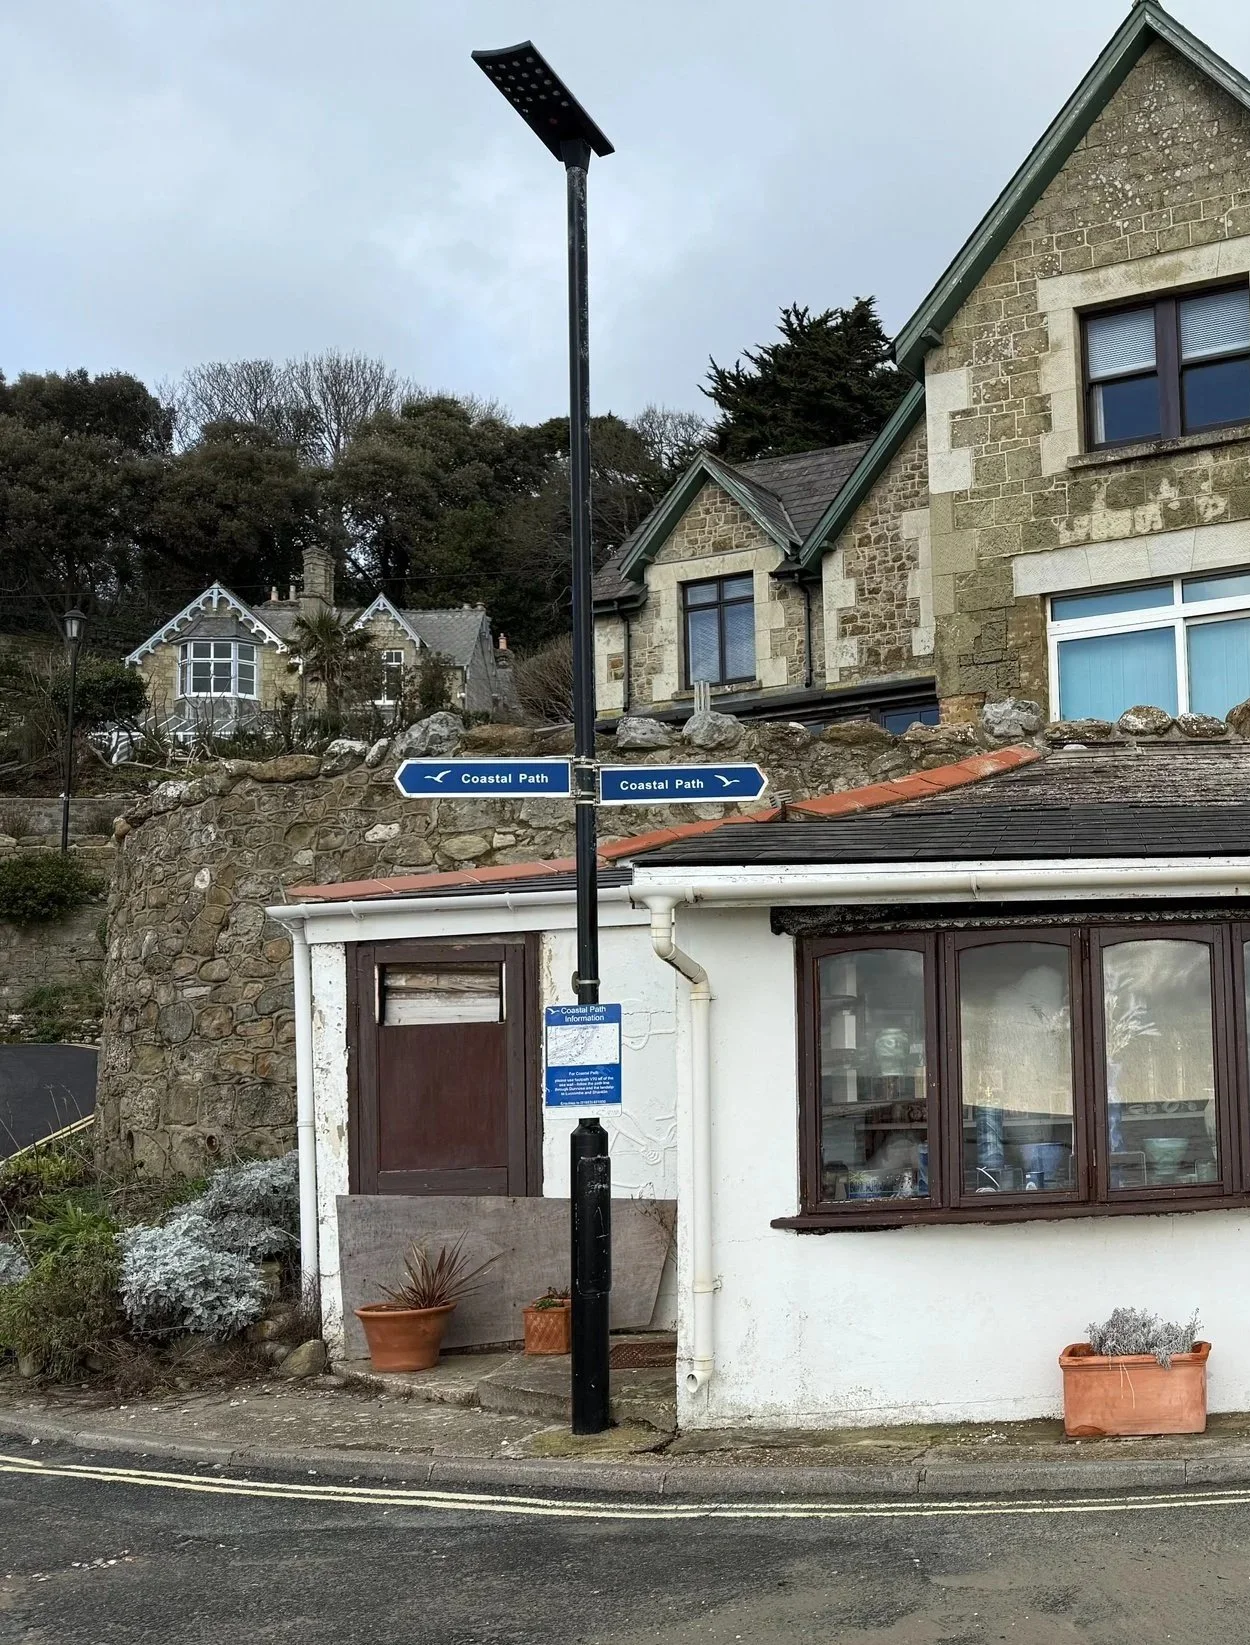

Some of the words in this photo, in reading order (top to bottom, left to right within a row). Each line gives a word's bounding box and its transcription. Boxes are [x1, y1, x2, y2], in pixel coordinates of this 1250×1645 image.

[461, 773, 512, 784] Coastal
[519, 773, 549, 784] Path
[620, 779, 669, 791] Coastal
[675, 778, 704, 789] Path
[560, 1006, 588, 1015] Coastal
[589, 1005, 607, 1013] Path
[564, 1014, 605, 1023] Information
